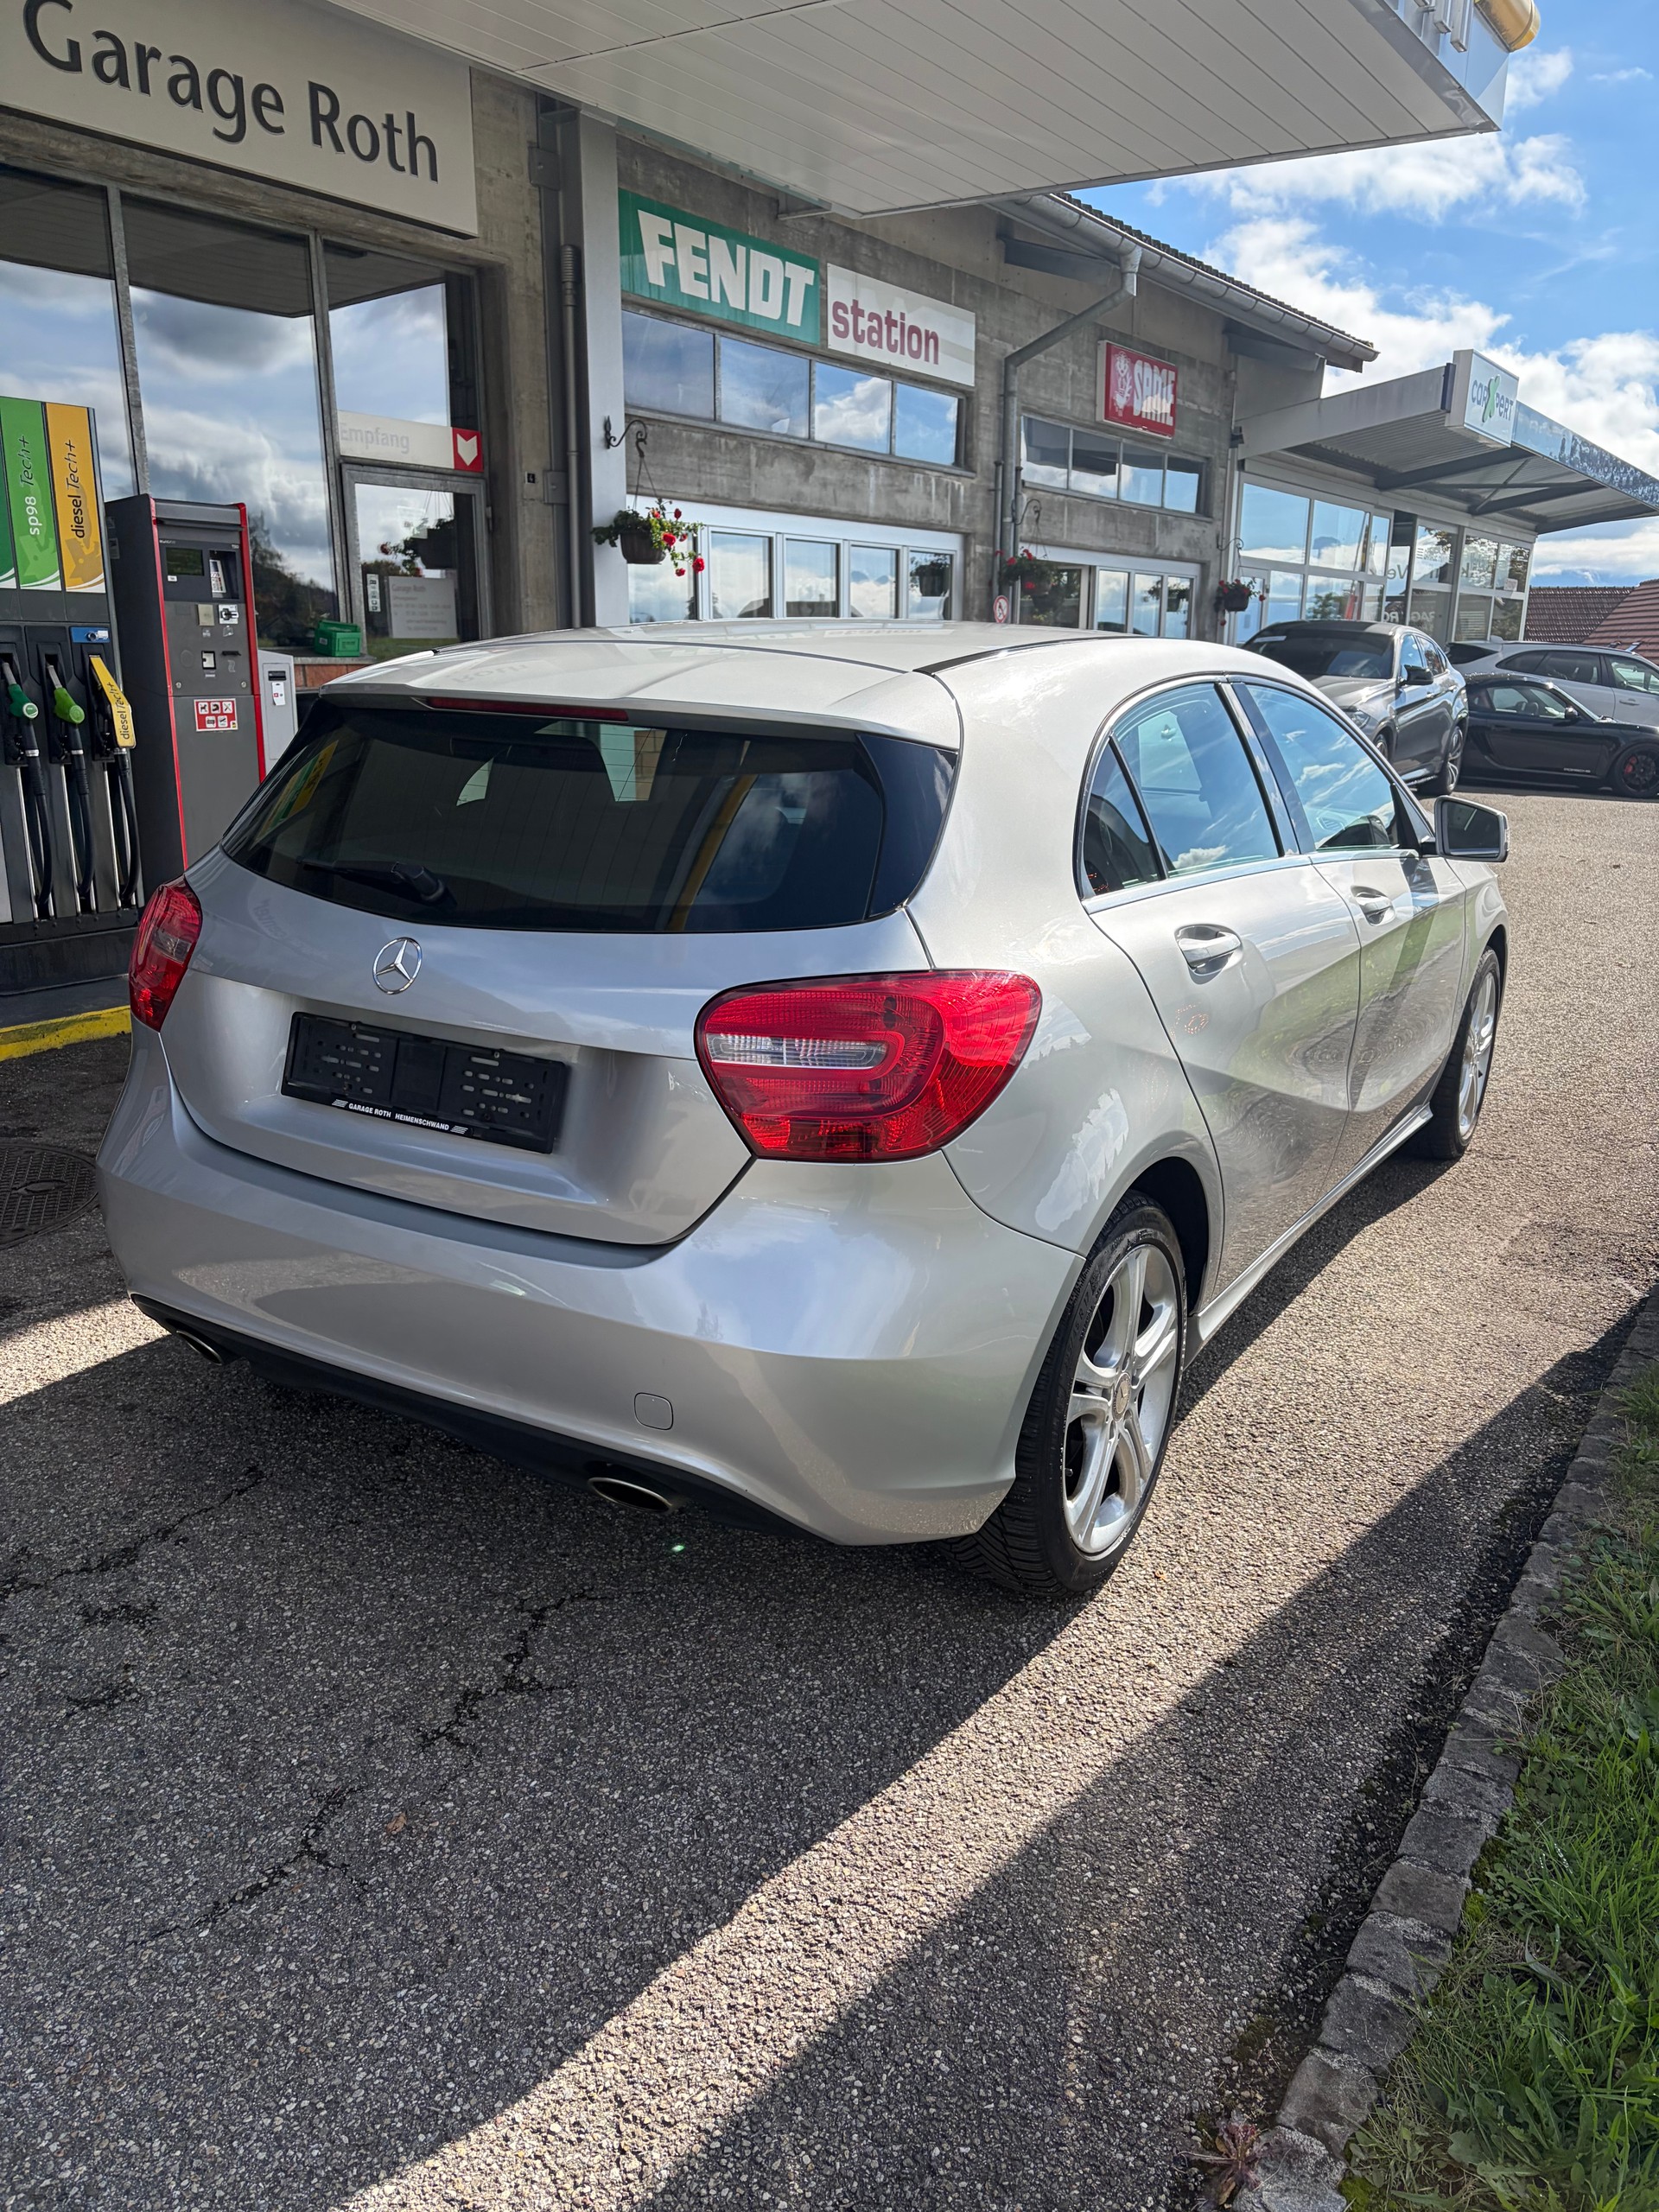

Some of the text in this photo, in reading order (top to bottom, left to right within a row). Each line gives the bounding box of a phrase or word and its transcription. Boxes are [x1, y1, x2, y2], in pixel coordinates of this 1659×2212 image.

[23, 0, 439, 184] Garage Roth
[637, 209, 816, 327] FENDT
[831, 299, 940, 365] station
[340, 423, 410, 454] Empfang
[18, 435, 42, 536] sp98 Tech+
[64, 439, 86, 539] diesel Tech+
[117, 710, 130, 741] diesel
[349, 1103, 449, 1130] GARAGE ROTH HEIMENSCHWAND
